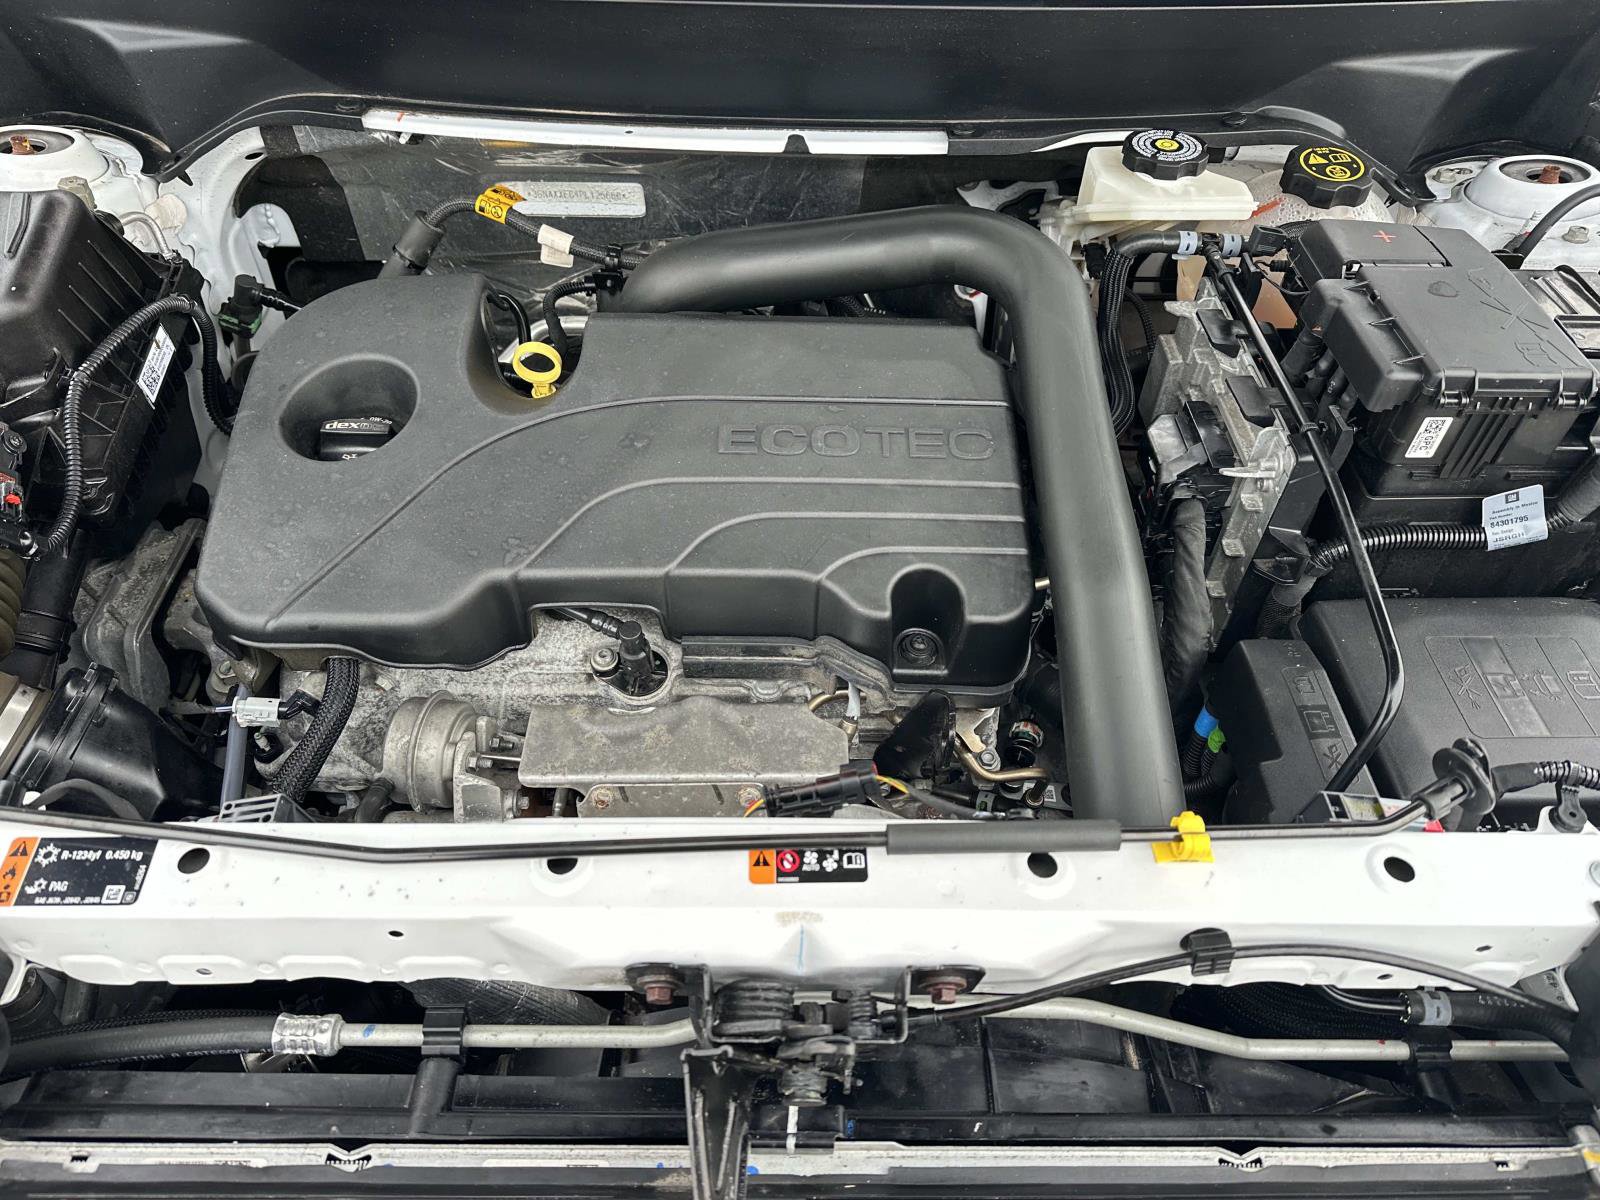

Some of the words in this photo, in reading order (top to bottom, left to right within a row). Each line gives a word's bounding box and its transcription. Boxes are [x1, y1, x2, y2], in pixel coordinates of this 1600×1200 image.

[718, 424, 996, 460] ECOTEC
[1490, 515, 1529, 529] 84301795
[60, 850, 102, 861] R-1234yf
[105, 850, 130, 860] 0.450
[131, 850, 143, 861] kg
[49, 881, 69, 892] PAG
